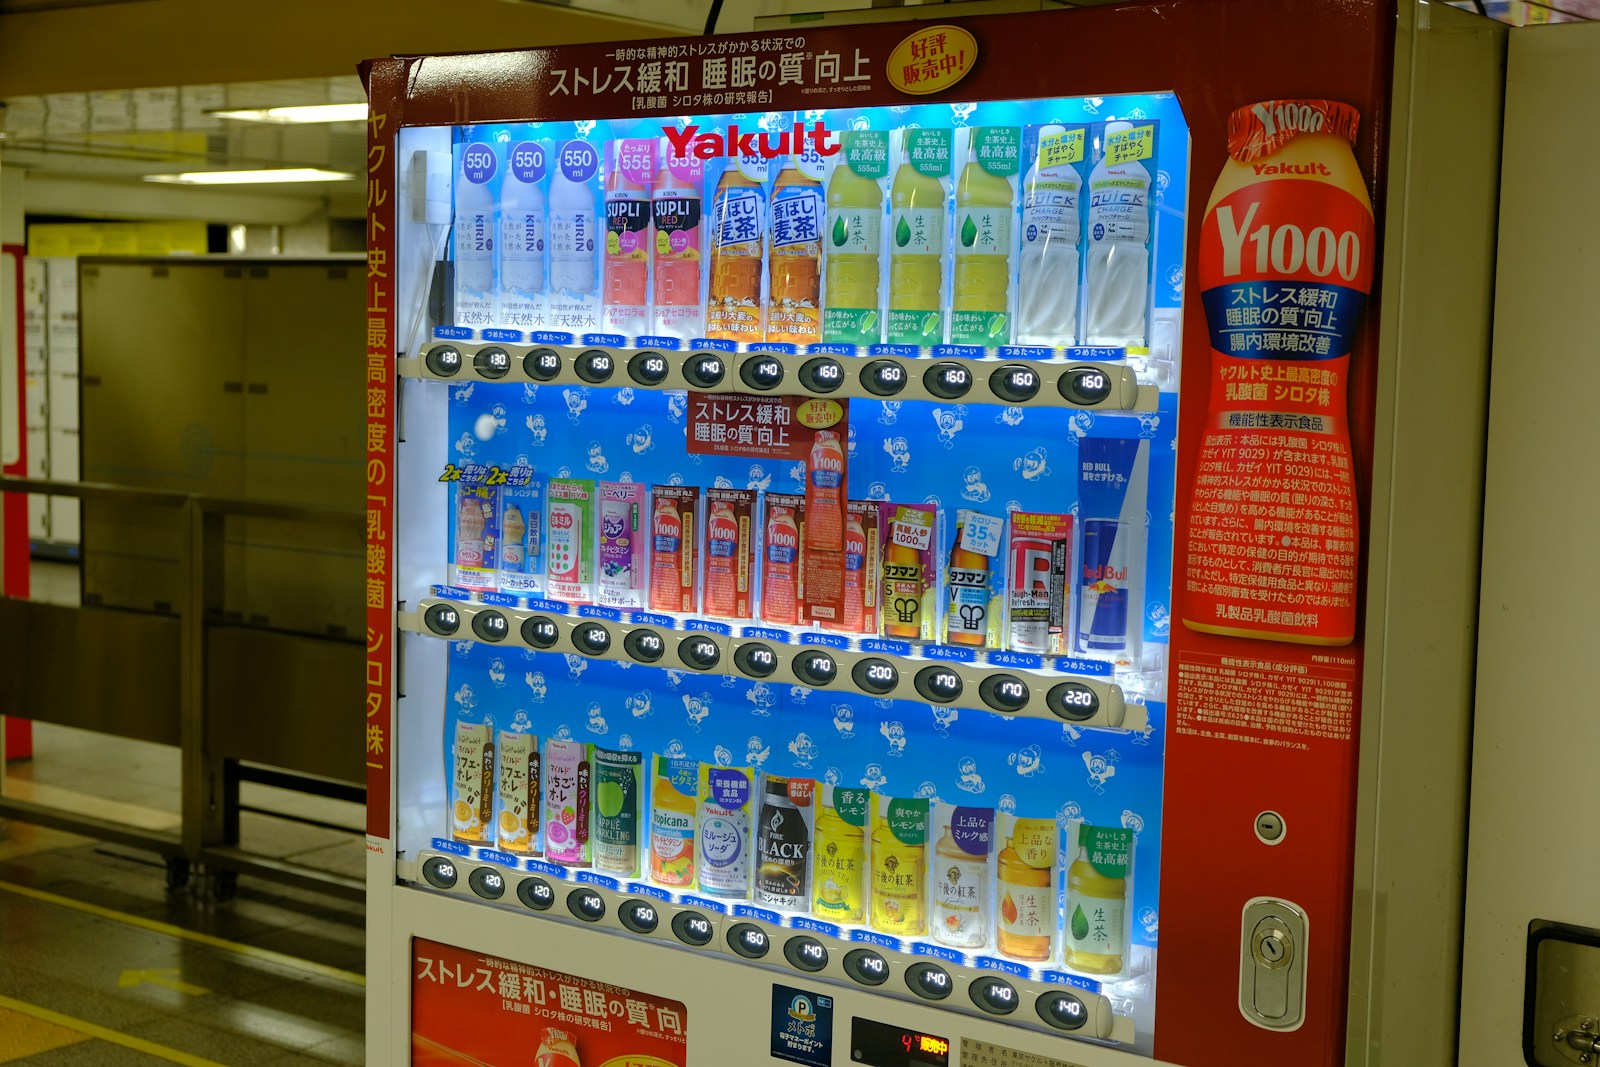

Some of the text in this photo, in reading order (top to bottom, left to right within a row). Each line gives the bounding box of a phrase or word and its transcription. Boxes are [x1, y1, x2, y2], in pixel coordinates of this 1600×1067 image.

[605, 36, 806, 63] 一時的な精神的ストレスがかかる状況での
[911, 32, 947, 61] 好評
[548, 60, 690, 97] ストレス緩和
[1250, 99, 1324, 138] Y1000
[661, 121, 843, 160] Yakult
[854, 139, 884, 148] 生茶史上
[917, 137, 946, 146] 生茶史上
[984, 135, 1016, 145] 生茶史上
[1041, 133, 1083, 149] 水分と塩分を
[1107, 129, 1151, 145] 水分と塩分を
[912, 146, 949, 160] 最高級
[979, 145, 1018, 159] 最高級
[1046, 143, 1074, 155] すばやく
[1113, 141, 1143, 154] すばやく
[466, 152, 492, 169] 550
[515, 150, 543, 168] 550
[564, 149, 592, 167] 550
[622, 154, 651, 170] 555
[849, 148, 886, 162] 最高級
[1047, 152, 1075, 164] チャージ
[1114, 149, 1144, 163] チャージ
[572, 168, 583, 177] ml
[857, 164, 880, 173] 555ml
[919, 162, 942, 172] 555ml
[987, 161, 1011, 171] 555ml
[1251, 162, 1332, 177] Yakult
[473, 170, 483, 179] ml
[523, 169, 534, 178] ml
[607, 202, 640, 218] SUPLI
[655, 202, 690, 217] SUPLI
[773, 199, 814, 219] 香ばし
[1097, 206, 1133, 214] CHARGE
[612, 217, 628, 226] RED
[661, 216, 678, 225] RED
[475, 214, 484, 251] KIRIN
[525, 214, 534, 251] KIRIN
[575, 214, 584, 252] KIRIN
[716, 216, 757, 241] 麦茶
[773, 215, 816, 242] 麦茶
[851, 214, 866, 246] 生茶
[913, 214, 928, 246] 生茶
[980, 214, 995, 246] 生茶
[1215, 201, 1361, 282] Y1000
[1231, 286, 1339, 310] ストレス緩和
[1229, 332, 1332, 356] 腸内環境改善
[441, 352, 457, 363] 130
[490, 353, 506, 366] 130
[540, 355, 557, 367] 130
[592, 358, 609, 370] 150
[646, 359, 663, 371] 150
[701, 362, 719, 373] 140
[759, 363, 778, 376] 140
[818, 365, 838, 378] 160
[880, 367, 900, 381] 160
[944, 370, 964, 384] 160
[1012, 373, 1033, 386] 160
[1219, 364, 1339, 387] ヤクルト史上最高密度の
[1081, 375, 1103, 388] 160
[1225, 382, 1331, 407] 乳酸菌 シロタ株
[695, 402, 791, 426] ストレス緩和
[809, 402, 829, 413] 好評
[1228, 412, 1324, 432] 機能性表示食品
[1221, 448, 1236, 459] YIT
[813, 452, 842, 471] Y1000
[1083, 461, 1111, 473] RED BULL
[1236, 461, 1282, 474] カゼイ YIT
[653, 517, 679, 537] Y1000
[970, 515, 999, 528] カロリー
[709, 521, 736, 541] Y1000
[768, 527, 796, 547] Y1000
[966, 523, 997, 542] 35%
[969, 538, 990, 550] カット
[885, 565, 919, 578] タフマン
[950, 570, 986, 585] タフマン
[1083, 564, 1127, 581] Red Bull
[441, 611, 456, 623] 110
[1215, 603, 1319, 628] 乳製品乳酸菌飲料
[488, 618, 504, 629] 110
[538, 624, 554, 635] 110
[589, 631, 606, 642] 120
[868, 665, 892, 679] 200
[1065, 690, 1092, 706] 220
[714, 778, 748, 790] 栄養機能
[722, 788, 739, 798] 食品
[841, 791, 866, 805] 香る
[653, 808, 689, 828] Tropicana
[705, 806, 735, 817] Yakult
[895, 807, 922, 819] 爽やか
[891, 820, 926, 832] レモン感
[956, 816, 986, 829] 上品な
[703, 828, 738, 844] ミルージュ
[769, 832, 784, 841] FIRE
[954, 829, 989, 843] ミルク感
[1019, 834, 1053, 847] 上品な
[1096, 831, 1128, 842] おいしさ
[708, 843, 731, 855] ソーダ
[757, 836, 805, 860] BLACK
[1095, 840, 1129, 852] 生茶史上
[1026, 849, 1048, 861] 香り
[1091, 850, 1130, 866] 最高級
[439, 864, 453, 877] 120
[485, 874, 501, 887] 120
[534, 885, 550, 898] 120
[584, 896, 601, 909] 140
[1025, 893, 1040, 926] 生茶
[637, 907, 653, 921] 150
[690, 919, 707, 933] 140
[1092, 906, 1109, 943] 生茶
[746, 931, 763, 945] 160
[804, 944, 822, 958] 140
[864, 957, 883, 971] 140
[478, 957, 631, 997] 一時的な精神的ストレスがかかる状況での
[926, 971, 948, 986] 140
[992, 984, 1012, 1000] 140
[1059, 999, 1080, 1013] 140
[787, 1020, 816, 1038] メトポ
[779, 1031, 824, 1048] 電子マネーポイント
